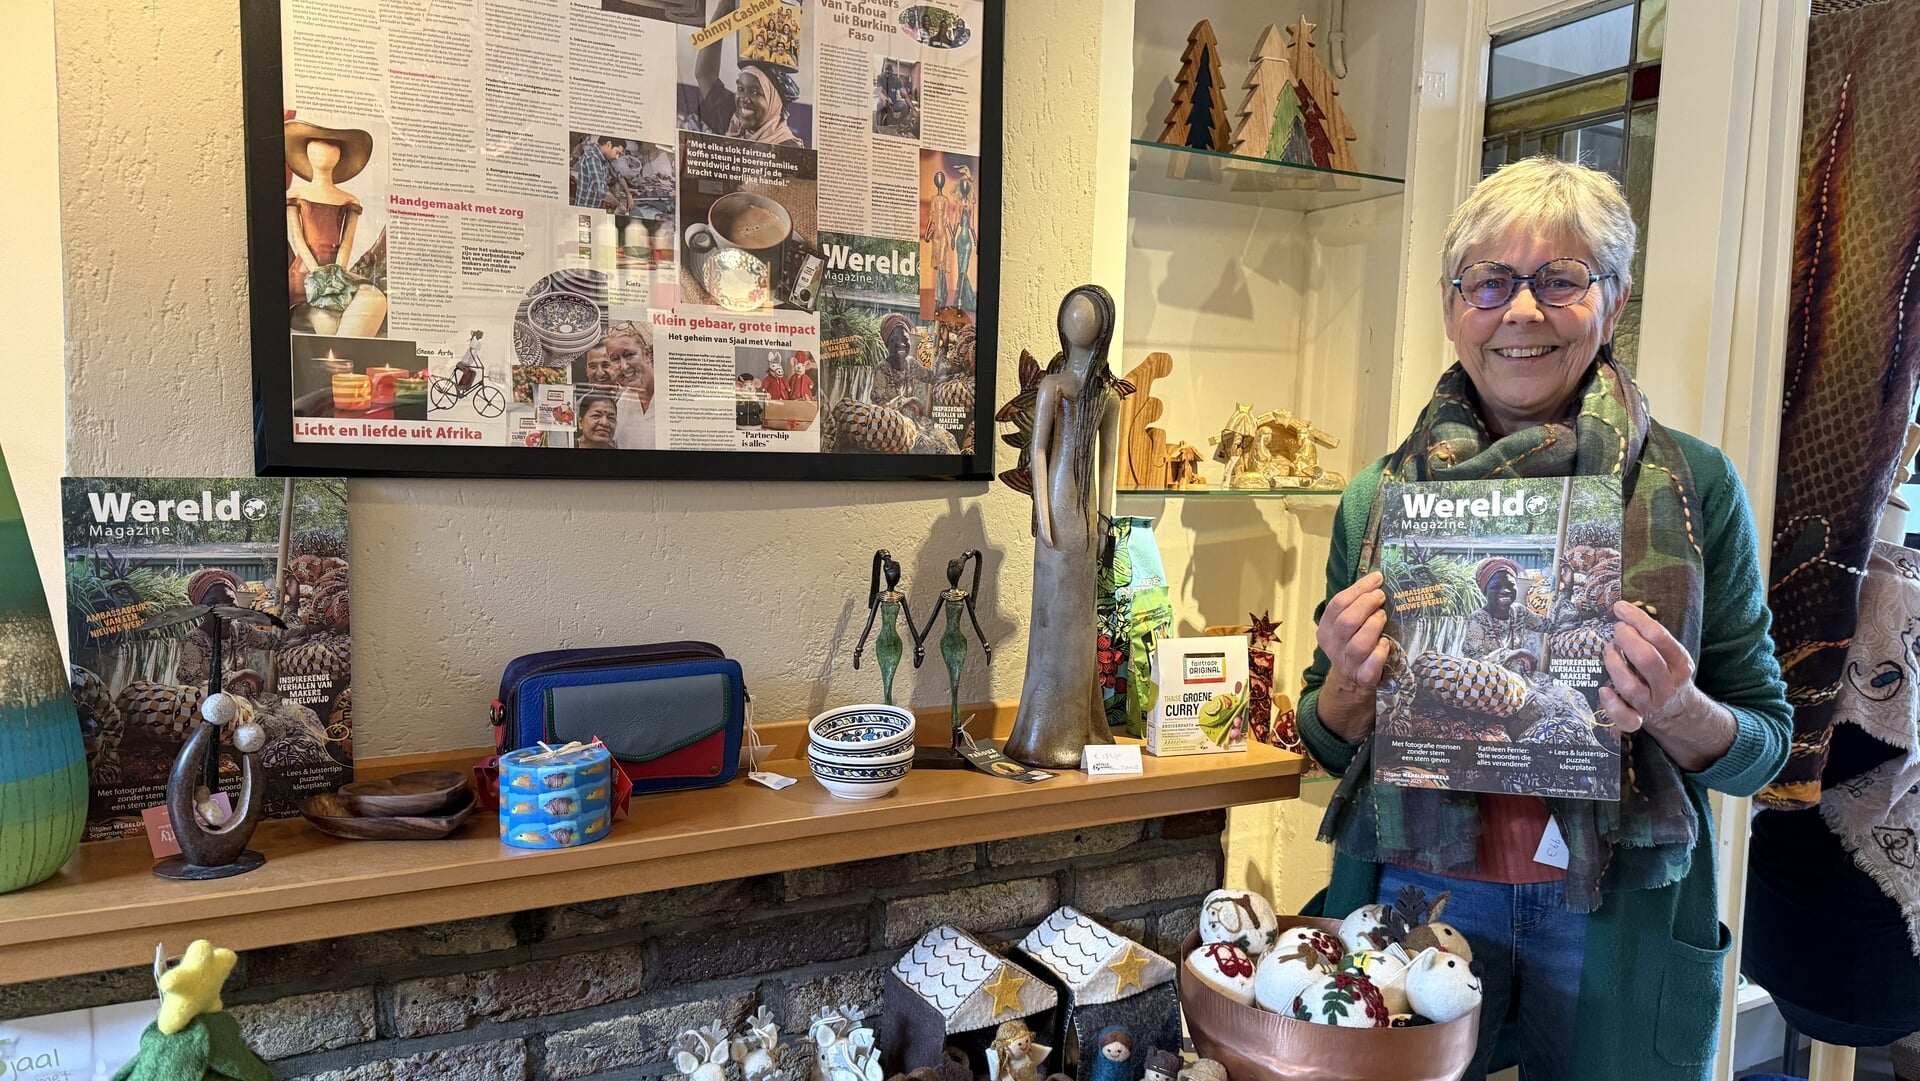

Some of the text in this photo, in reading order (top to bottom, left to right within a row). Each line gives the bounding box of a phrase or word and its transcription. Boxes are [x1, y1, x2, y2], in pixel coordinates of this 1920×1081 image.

[845, 1, 886, 19] Tahoua
[691, 0, 775, 45] Johnny Cashew
[834, 13, 897, 34] uit Burkina
[848, 28, 874, 42] Faso
[707, 143, 724, 152] elke
[725, 145, 741, 155] slok
[742, 147, 776, 159] fairtrade
[687, 149, 798, 171] koffie steun je boerenfamilies
[687, 159, 782, 178] wereldwijd en proef je de
[687, 166, 712, 177] kracht
[714, 171, 728, 179] van
[729, 173, 758, 184] eerlijke
[390, 194, 524, 219] Handgemaakt met zorg
[822, 243, 916, 276] Wereld
[653, 313, 815, 336] Klein gebaar, grote impact
[668, 333, 682, 341] Het
[684, 334, 712, 343] geheim
[729, 337, 747, 347] Sjaal
[764, 339, 792, 347] Verhaal
[295, 423, 483, 440] Licht en liefde uit Afrika
[88, 490, 240, 523] Wereld
[1403, 489, 1524, 519] Wereld
[89, 524, 170, 539] Magazine
[1401, 520, 1465, 531] Magazine
[104, 613, 138, 627] VAN EEN
[90, 625, 122, 638] NIEUWE
[1189, 667, 1220, 675] ORIGINAL
[279, 674, 331, 684] INSPIRERENDE
[1552, 679, 1598, 687] WERELDWIJD
[277, 682, 317, 692] VERHALEN
[289, 689, 322, 698] MAKERS
[1183, 692, 1213, 702] GROENE
[282, 695, 329, 706] WERELDWIJD
[1166, 704, 1199, 716] CURRY
[1405, 741, 1434, 749] fotografie
[1478, 745, 1506, 753] Kathleen
[1576, 750, 1608, 758] luistertips
[287, 767, 302, 777] Lees
[310, 765, 343, 775] luistertips
[1559, 763, 1597, 771] kleurplaten
[299, 774, 324, 784] puzzels
[114, 785, 151, 795] fotografie
[293, 781, 331, 791] kleurplaten
[117, 793, 144, 802] zonder
[127, 801, 146, 809] stem
